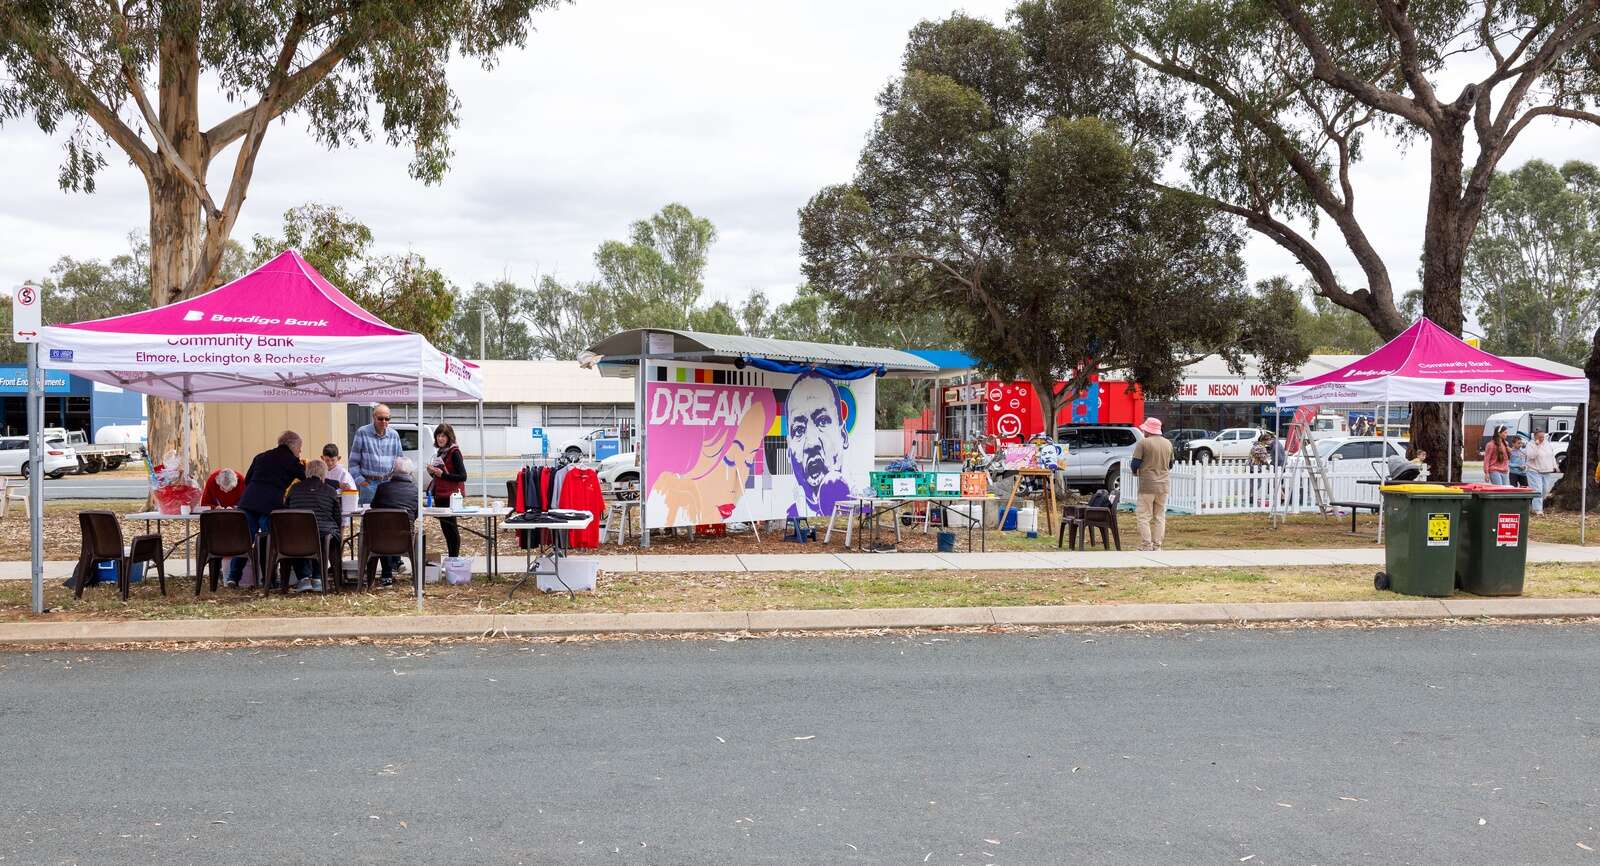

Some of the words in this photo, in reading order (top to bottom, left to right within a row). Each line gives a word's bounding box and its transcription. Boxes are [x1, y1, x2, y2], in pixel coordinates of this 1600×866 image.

[210, 314, 281, 325] Bendigo
[284, 317, 329, 327] Bank
[167, 334, 253, 350] Community
[257, 335, 295, 348] Bank
[135, 352, 180, 363] Elmore,
[183, 352, 250, 366] Lockington
[254, 353, 262, 363] &
[265, 353, 326, 364] Rochester
[1178, 384, 1198, 396] EME
[1208, 384, 1239, 396] NELSON
[1460, 383, 1502, 396] Bendigo
[1505, 383, 1532, 394] Bank
[649, 387, 755, 427] DREAM
